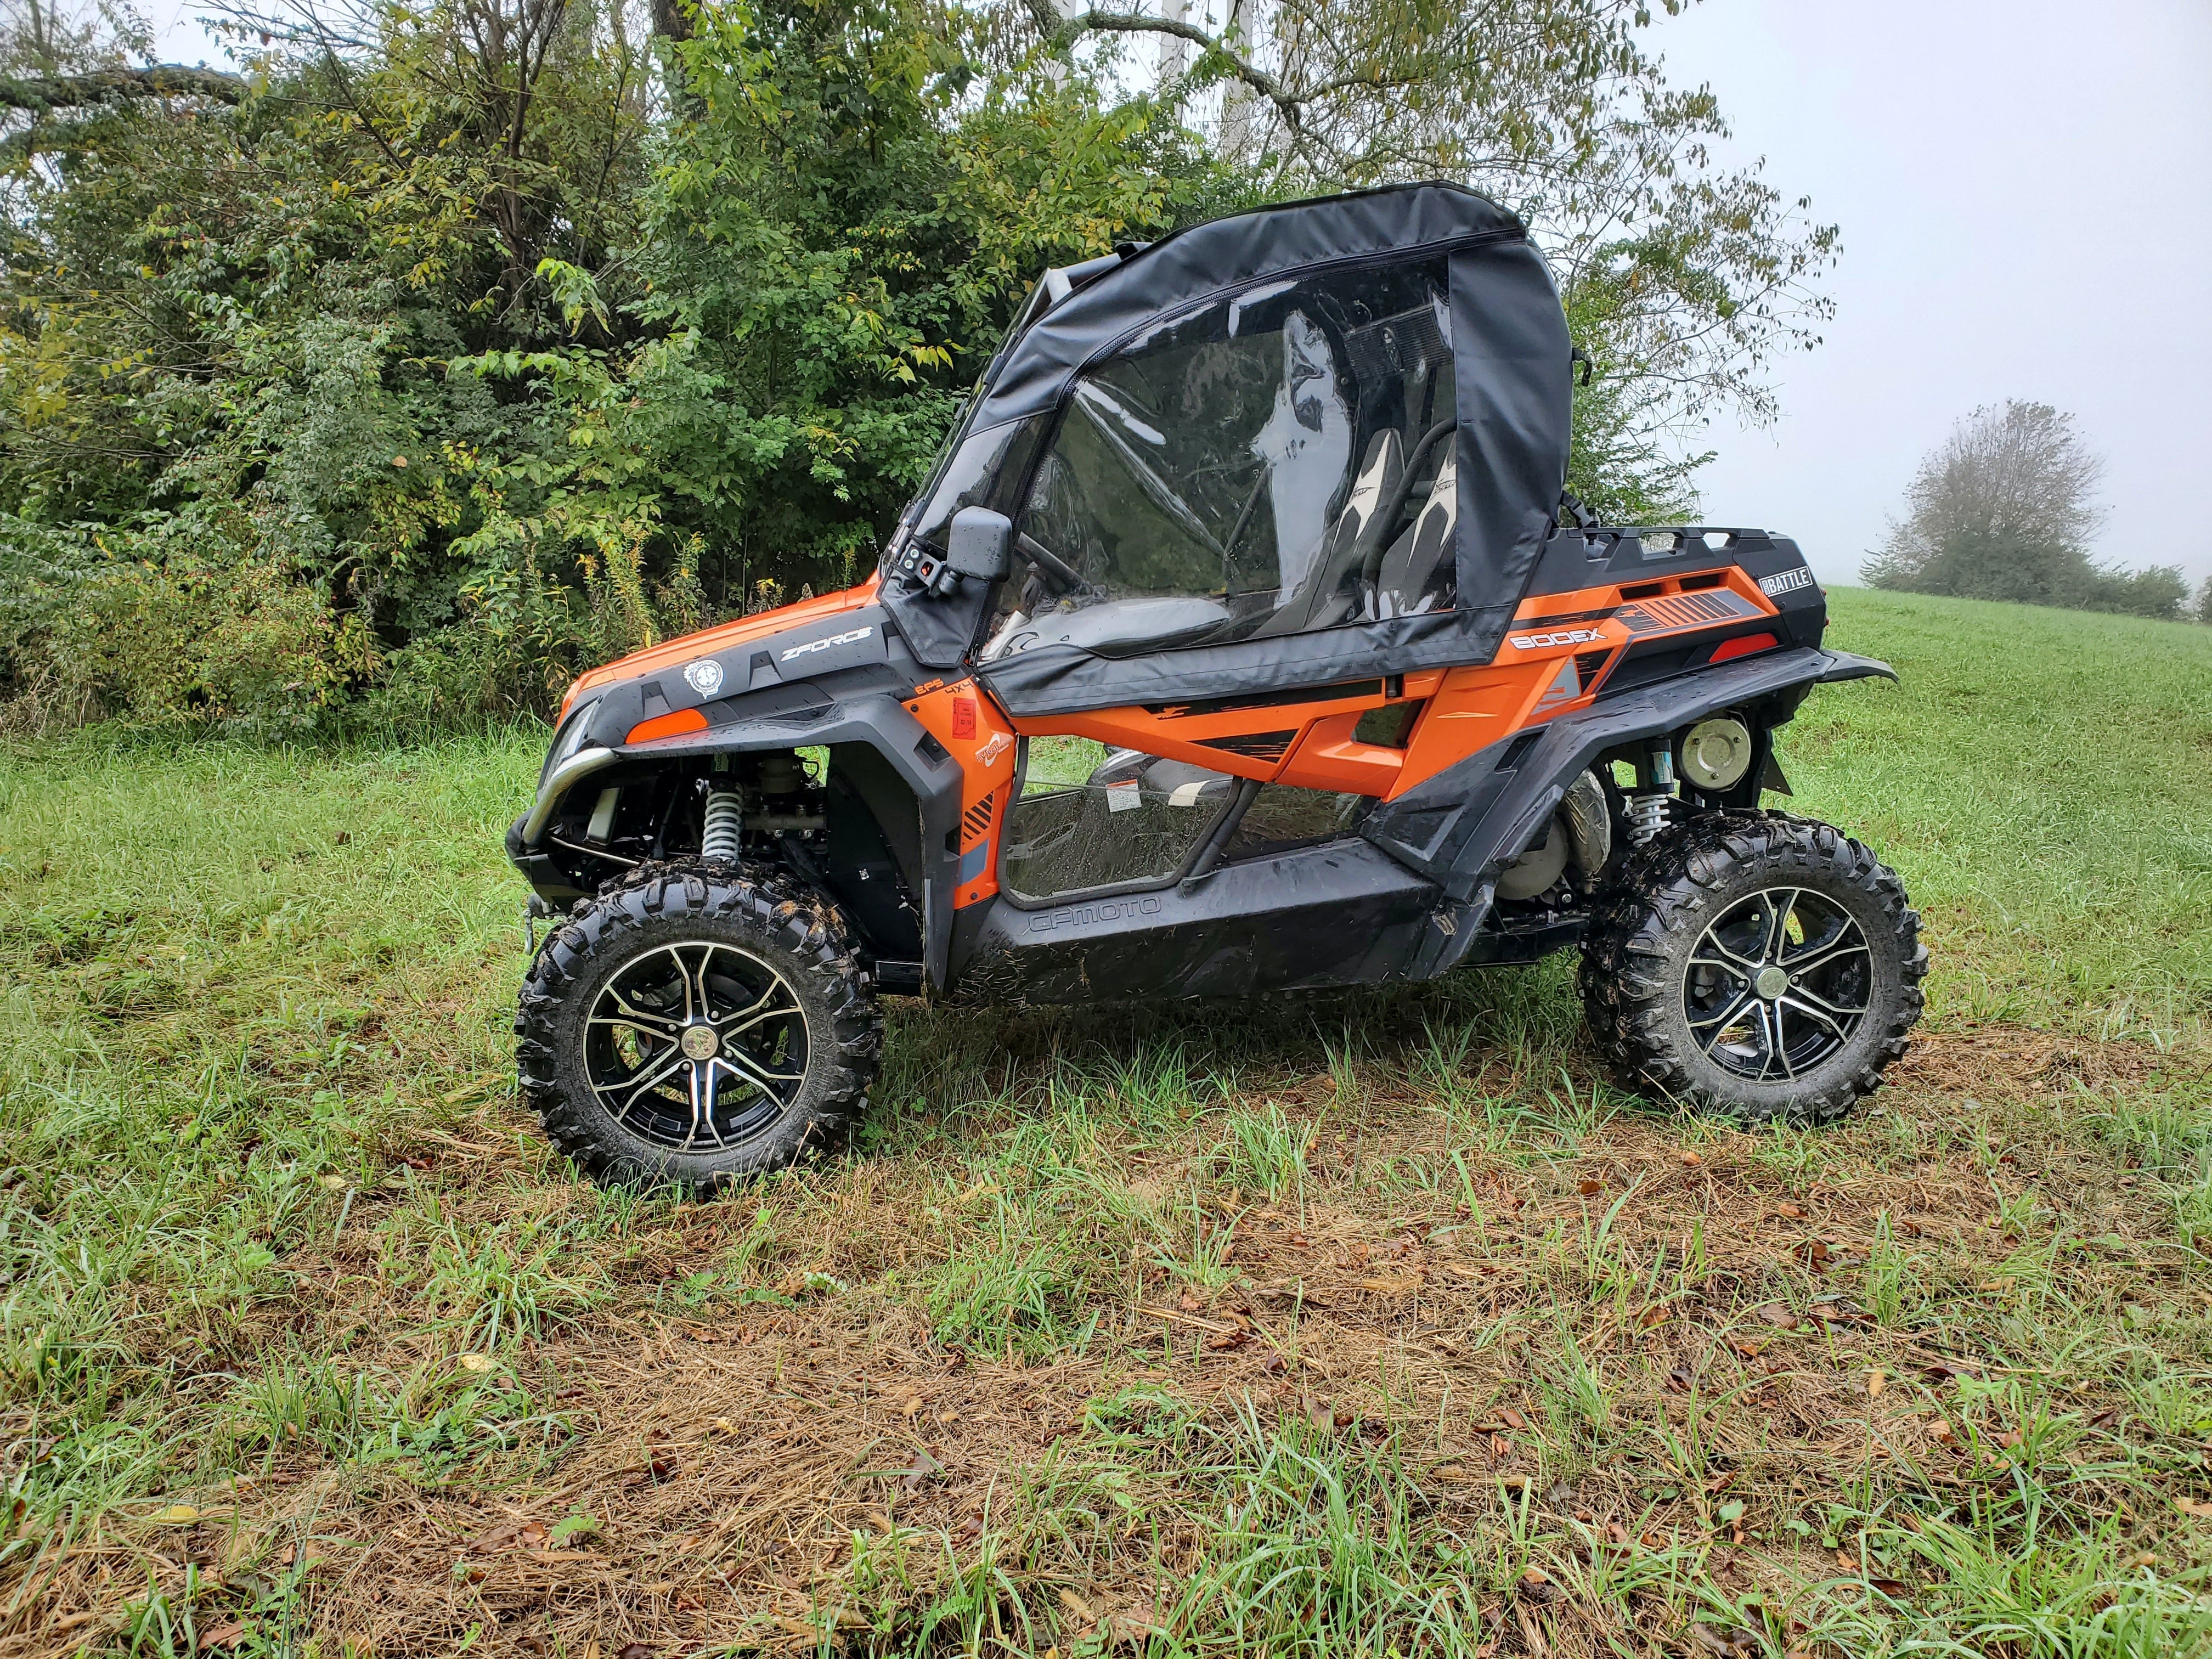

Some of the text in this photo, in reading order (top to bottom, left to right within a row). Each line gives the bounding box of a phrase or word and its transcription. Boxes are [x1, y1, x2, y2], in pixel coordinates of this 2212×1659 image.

[1767, 569, 1809, 594] BATTLE
[781, 626, 874, 662] ZFORCE
[1509, 628, 1607, 650] 800EX
[915, 678, 944, 695] EPS
[1029, 896, 1161, 932] CFMOTO
